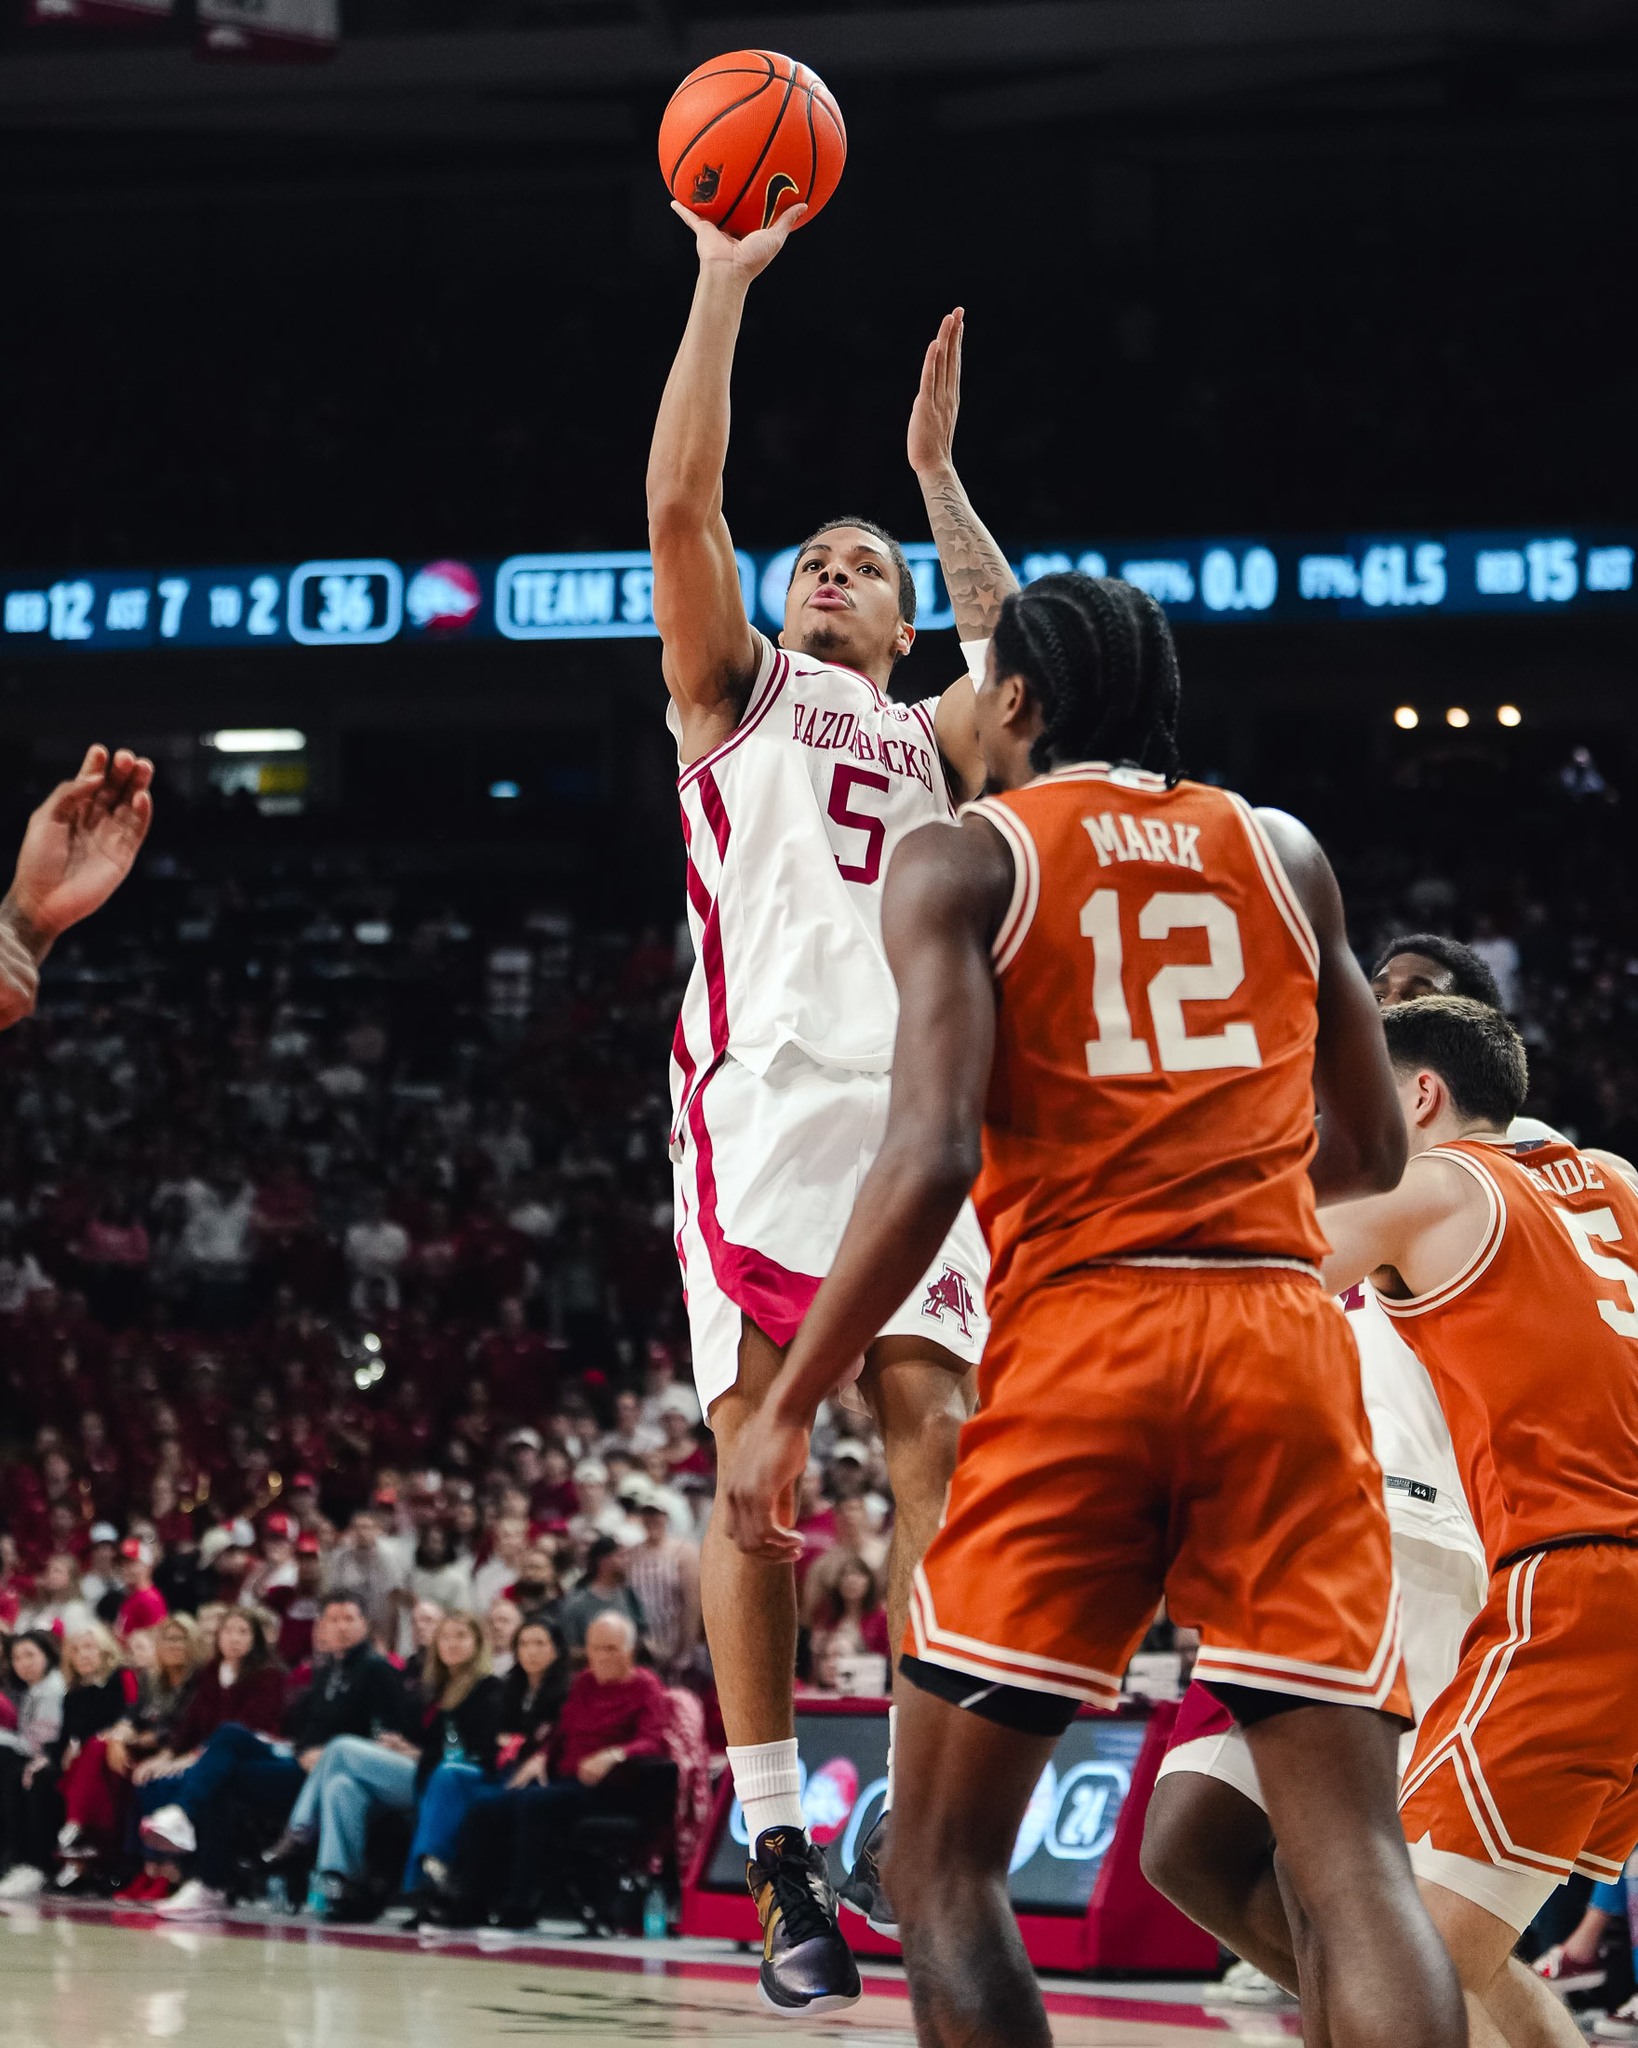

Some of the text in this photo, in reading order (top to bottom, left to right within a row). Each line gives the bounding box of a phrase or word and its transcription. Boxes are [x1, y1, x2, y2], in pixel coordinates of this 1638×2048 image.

[50, 581, 94, 640] 12
[157, 577, 189, 638] 7
[248, 574, 279, 635] 2
[318, 575, 374, 634] 36
[512, 569, 615, 627] TEAM
[1202, 548, 1276, 610] 0.0
[1362, 544, 1446, 607] 61.5
[1526, 539, 1577, 601] 15
[828, 763, 890, 885] 5
[1081, 811, 1204, 873] MARK
[1079, 888, 1262, 1077] 12
[1552, 1206, 1638, 1340] 5
[1414, 1486, 1427, 1498] 44
